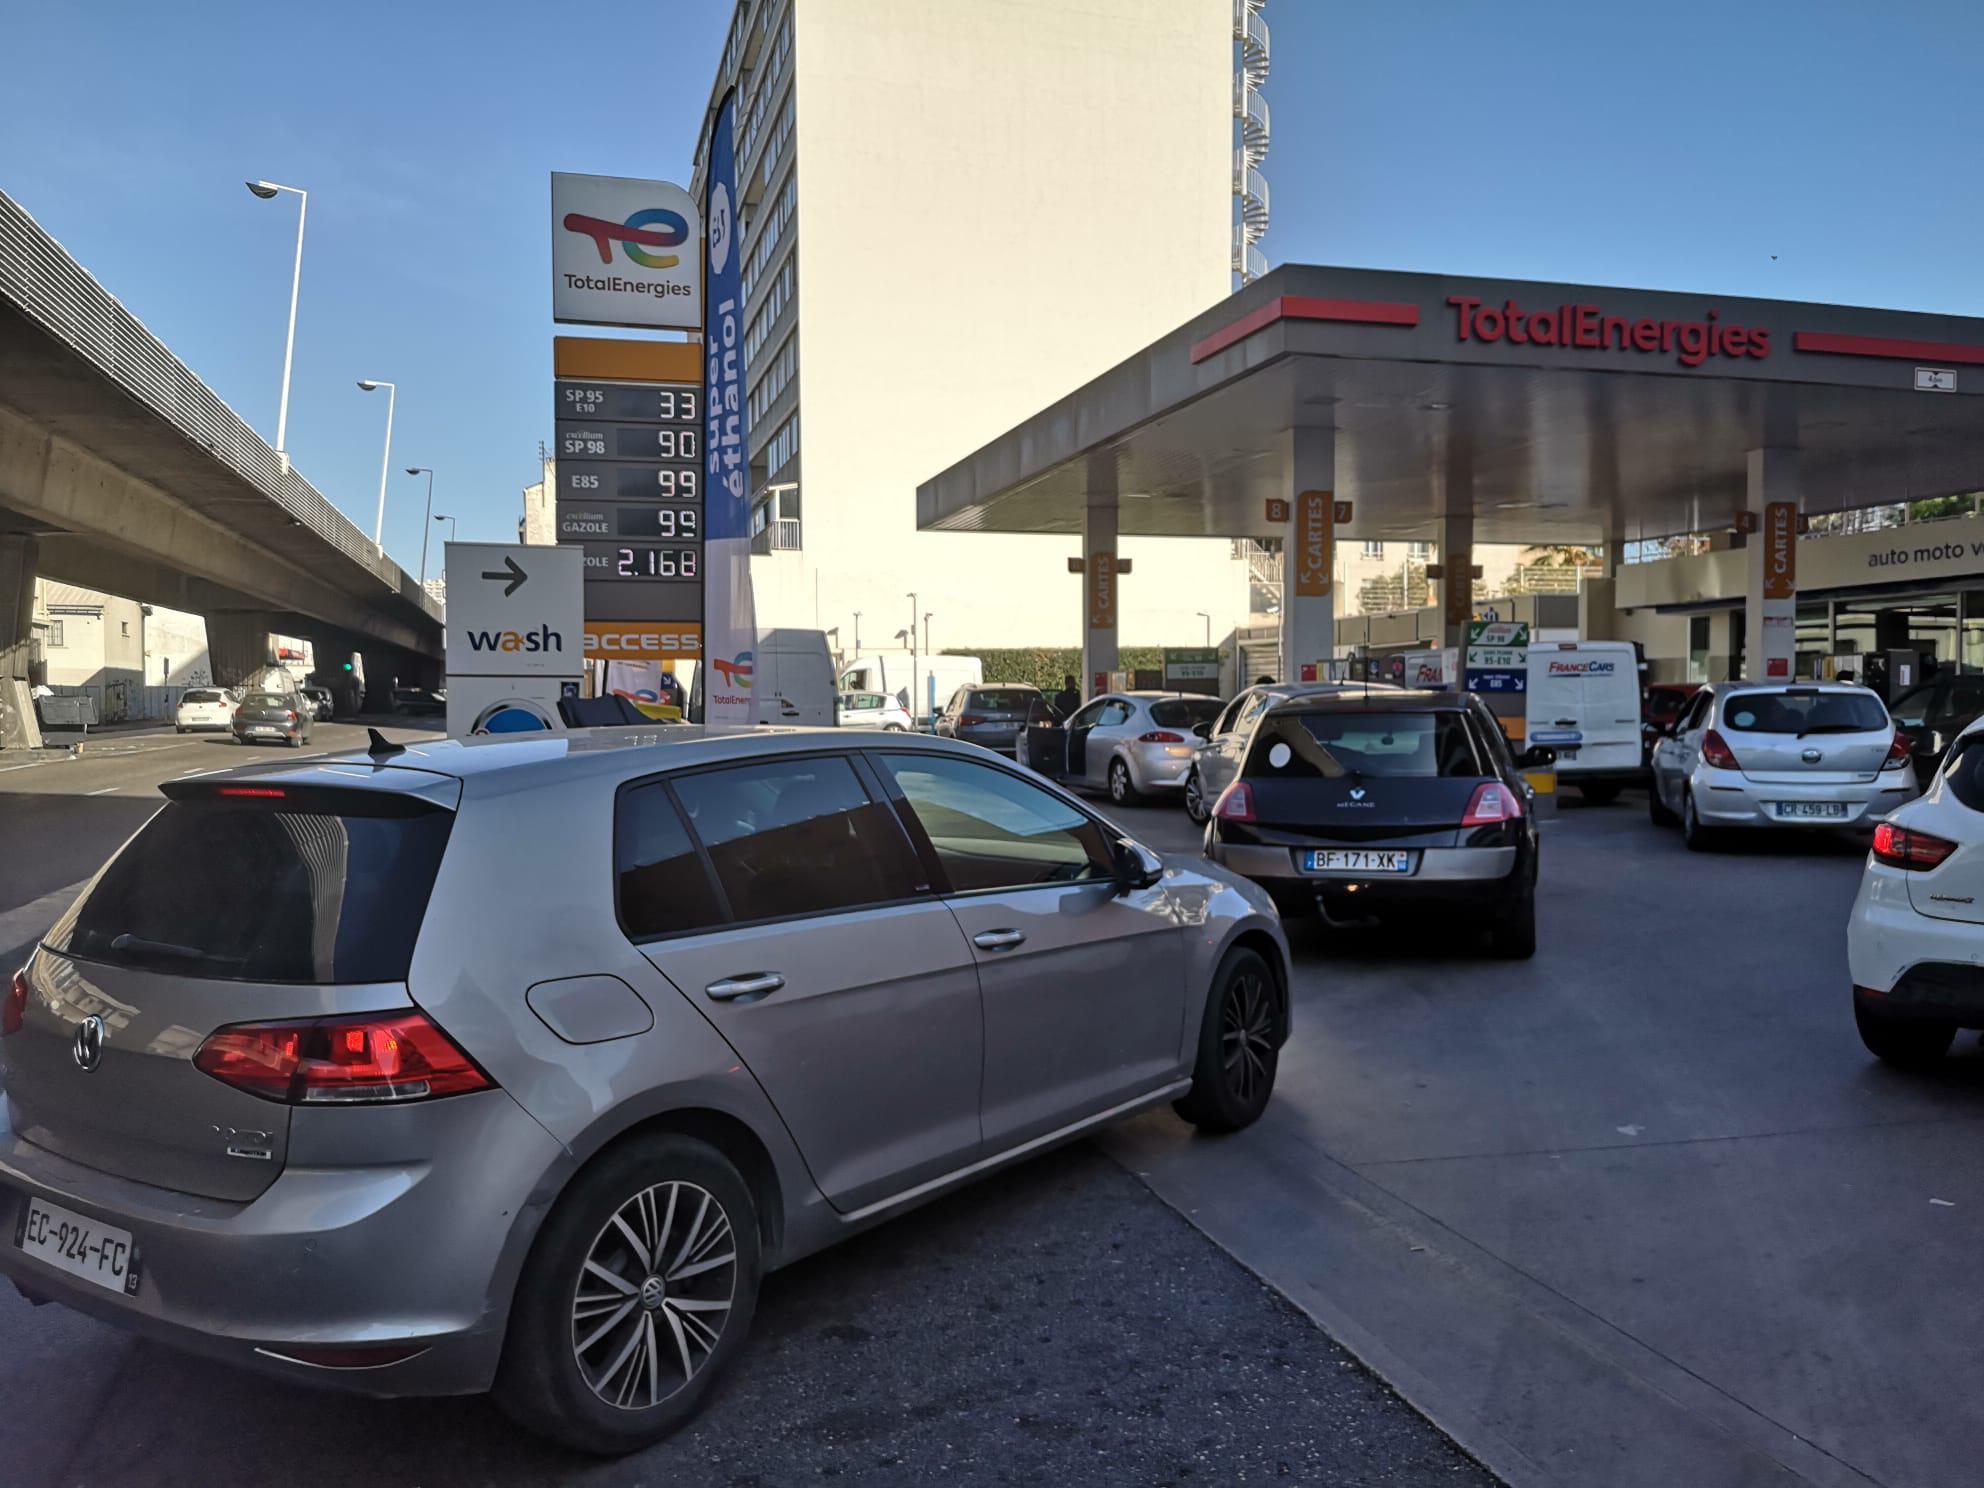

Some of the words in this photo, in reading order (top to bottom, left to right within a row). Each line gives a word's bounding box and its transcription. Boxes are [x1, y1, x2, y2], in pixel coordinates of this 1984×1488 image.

[563, 273, 692, 299] TotalEnergies
[1447, 296, 1772, 367] TotalEnergies
[565, 389, 584, 402] SP
[586, 390, 604, 403] 95
[576, 403, 596, 413] E10
[660, 391, 696, 420] 33
[709, 335, 723, 475] super
[718, 298, 744, 498] éthanol
[564, 439, 585, 453] SP
[586, 440, 606, 454] 98
[658, 430, 696, 458] 90
[571, 474, 600, 489] E85
[658, 470, 696, 498] 99
[658, 509, 696, 537] 99
[1271, 503, 1281, 519] 8
[1337, 503, 1347, 520] 7
[562, 521, 609, 533] GAZOLE
[1307, 497, 1323, 570] CARTES
[1774, 507, 1788, 574] CARTES
[617, 548, 696, 577] 2.168
[1868, 548, 1909, 568] auto
[1914, 542, 1964, 563] moto
[466, 623, 562, 653] wash
[1315, 851, 1396, 868] BF-171-XK
[26, 1208, 127, 1277] EC-924-FC
[127, 1272, 139, 1290] 13
